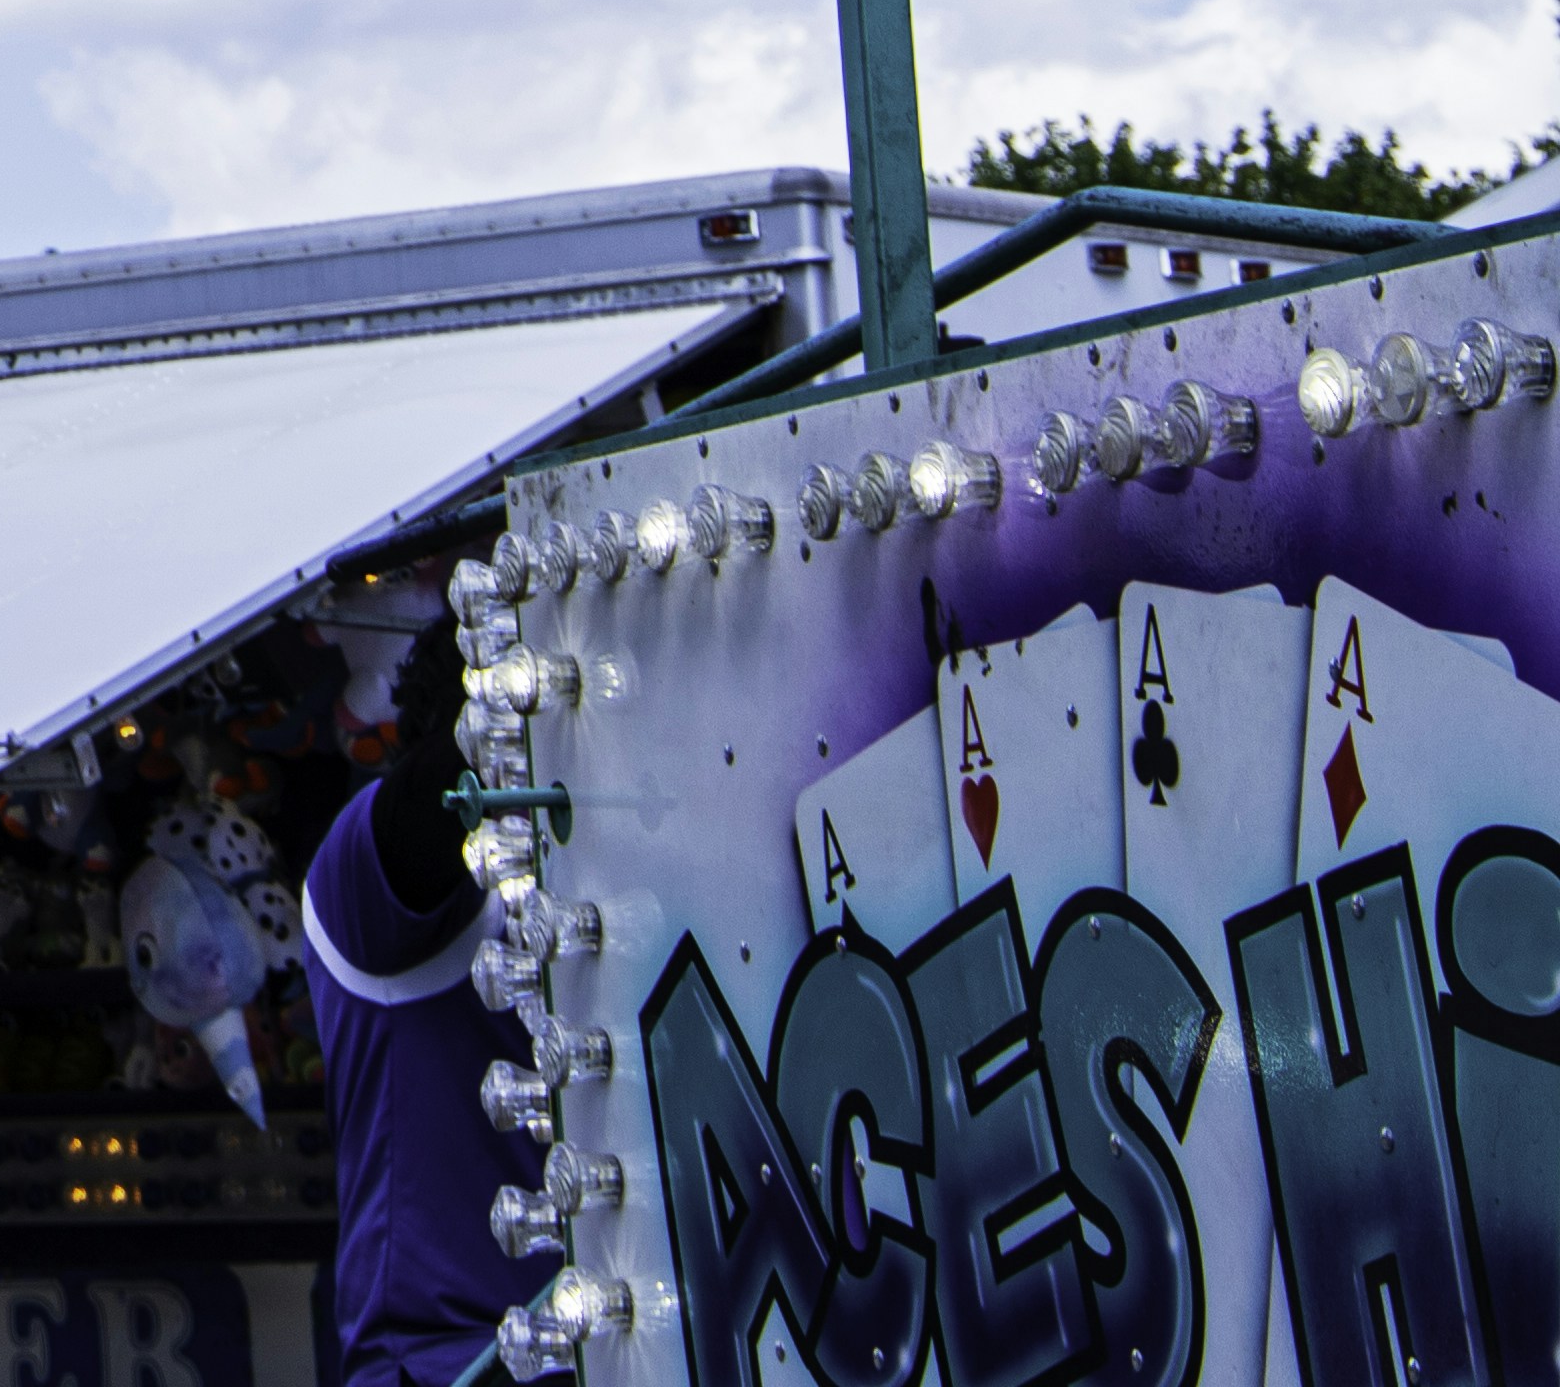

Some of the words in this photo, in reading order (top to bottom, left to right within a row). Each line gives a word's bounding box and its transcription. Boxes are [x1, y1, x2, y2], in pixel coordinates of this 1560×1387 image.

[1135, 603, 1174, 704] A
[1325, 614, 1375, 723] A
[959, 683, 993, 773] A
[822, 808, 856, 904] A
